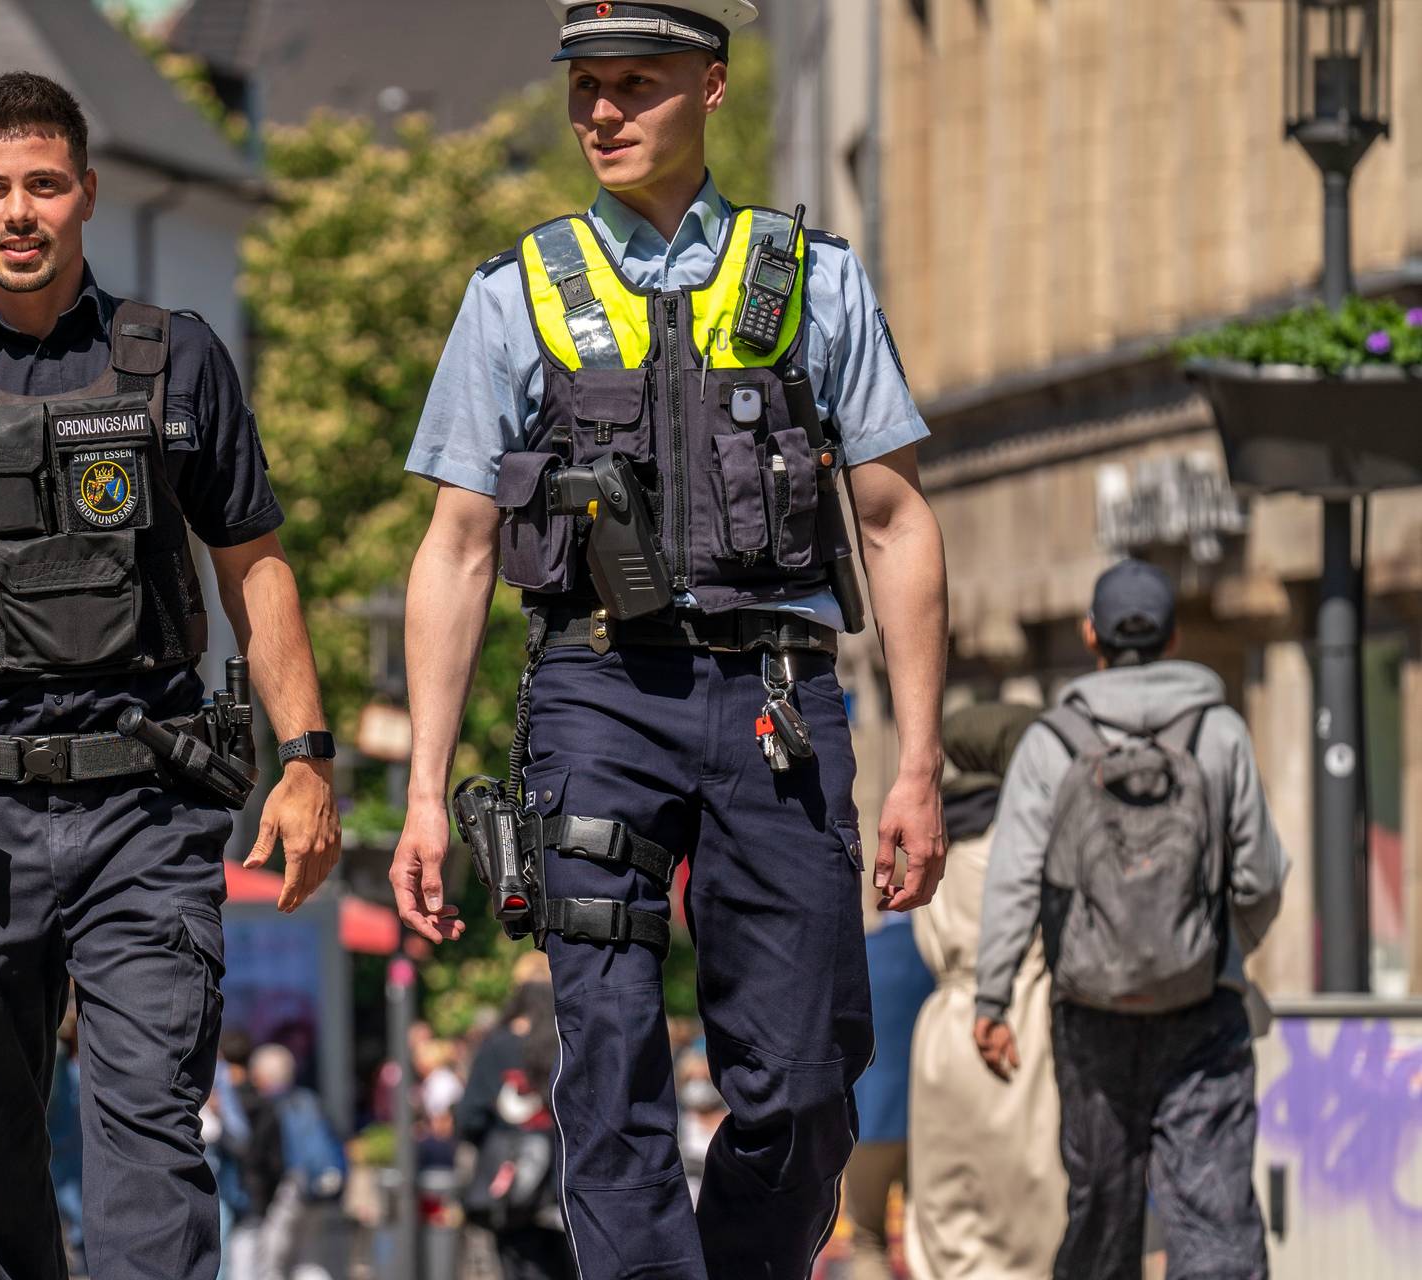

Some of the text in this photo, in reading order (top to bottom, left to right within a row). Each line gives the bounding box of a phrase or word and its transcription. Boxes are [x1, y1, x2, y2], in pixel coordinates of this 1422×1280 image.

[56, 414, 146, 436] ORDNUNGSAMT
[73, 449, 133, 463] STADT ESSEN
[76, 494, 137, 525] ORDNUNGSAMT
